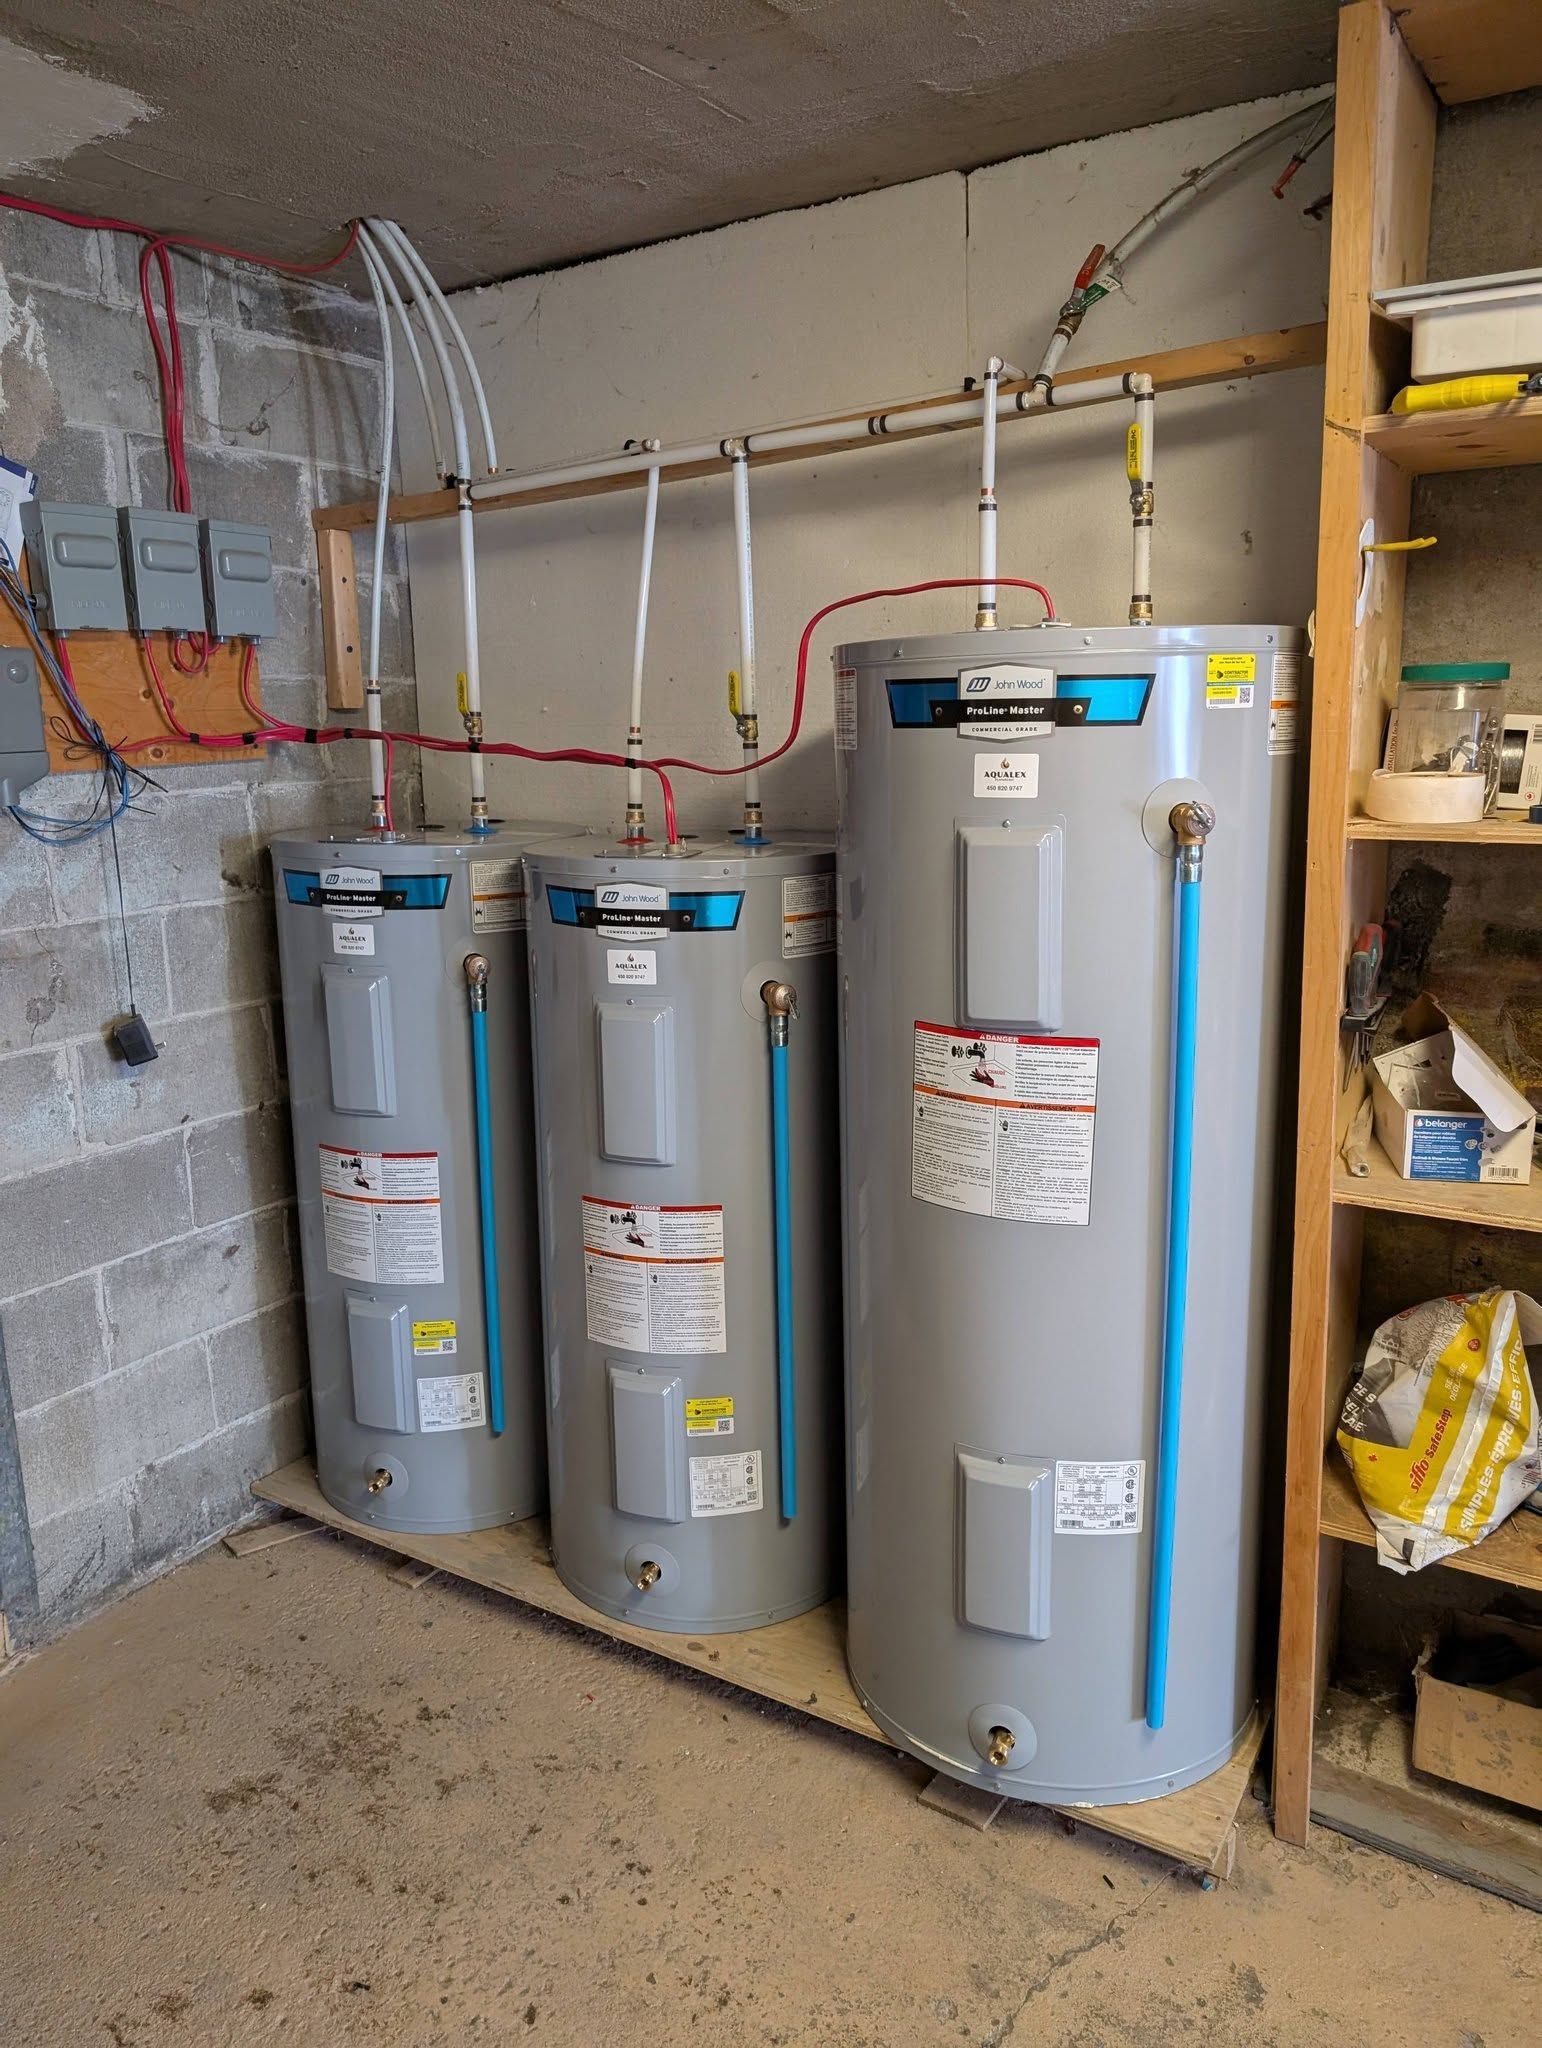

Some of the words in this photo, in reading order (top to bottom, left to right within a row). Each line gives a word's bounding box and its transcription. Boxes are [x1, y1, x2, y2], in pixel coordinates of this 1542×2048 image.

[994, 679, 1015, 690] John
[1017, 679, 1043, 689] Wood
[1009, 706, 1045, 715] Master
[984, 771, 1027, 779] AQUALEX
[341, 876, 356, 884] John
[352, 894, 376, 902] Master
[621, 894, 638, 903] John
[634, 914, 662, 922] Master
[985, 1034, 1020, 1044] DANGER
[1425, 1118, 1468, 1129] belanger
[1409, 1458, 1430, 1494] siffo
[1424, 1408, 1453, 1458] SafeStep
